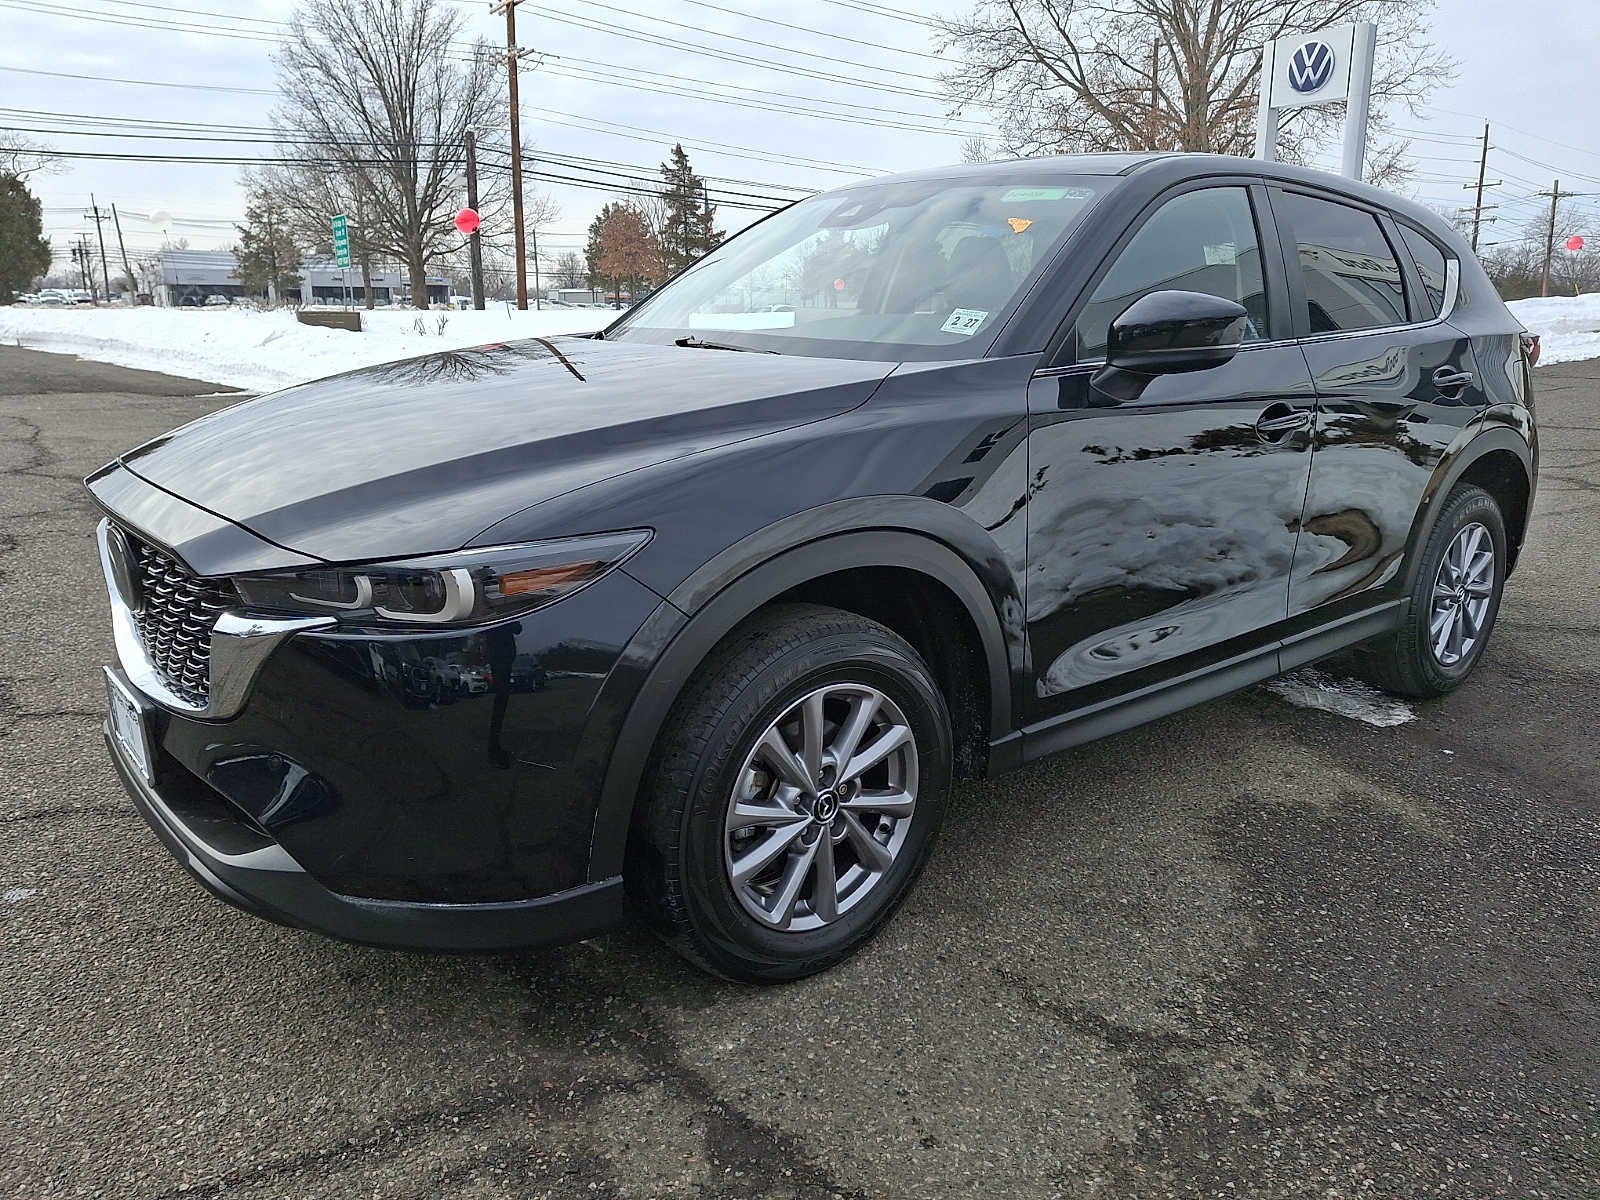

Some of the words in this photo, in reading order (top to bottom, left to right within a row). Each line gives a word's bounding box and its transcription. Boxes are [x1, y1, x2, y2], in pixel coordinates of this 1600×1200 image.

[1288, 40, 1334, 93] VW
[951, 316, 961, 326] 2
[963, 318, 979, 328] 27
